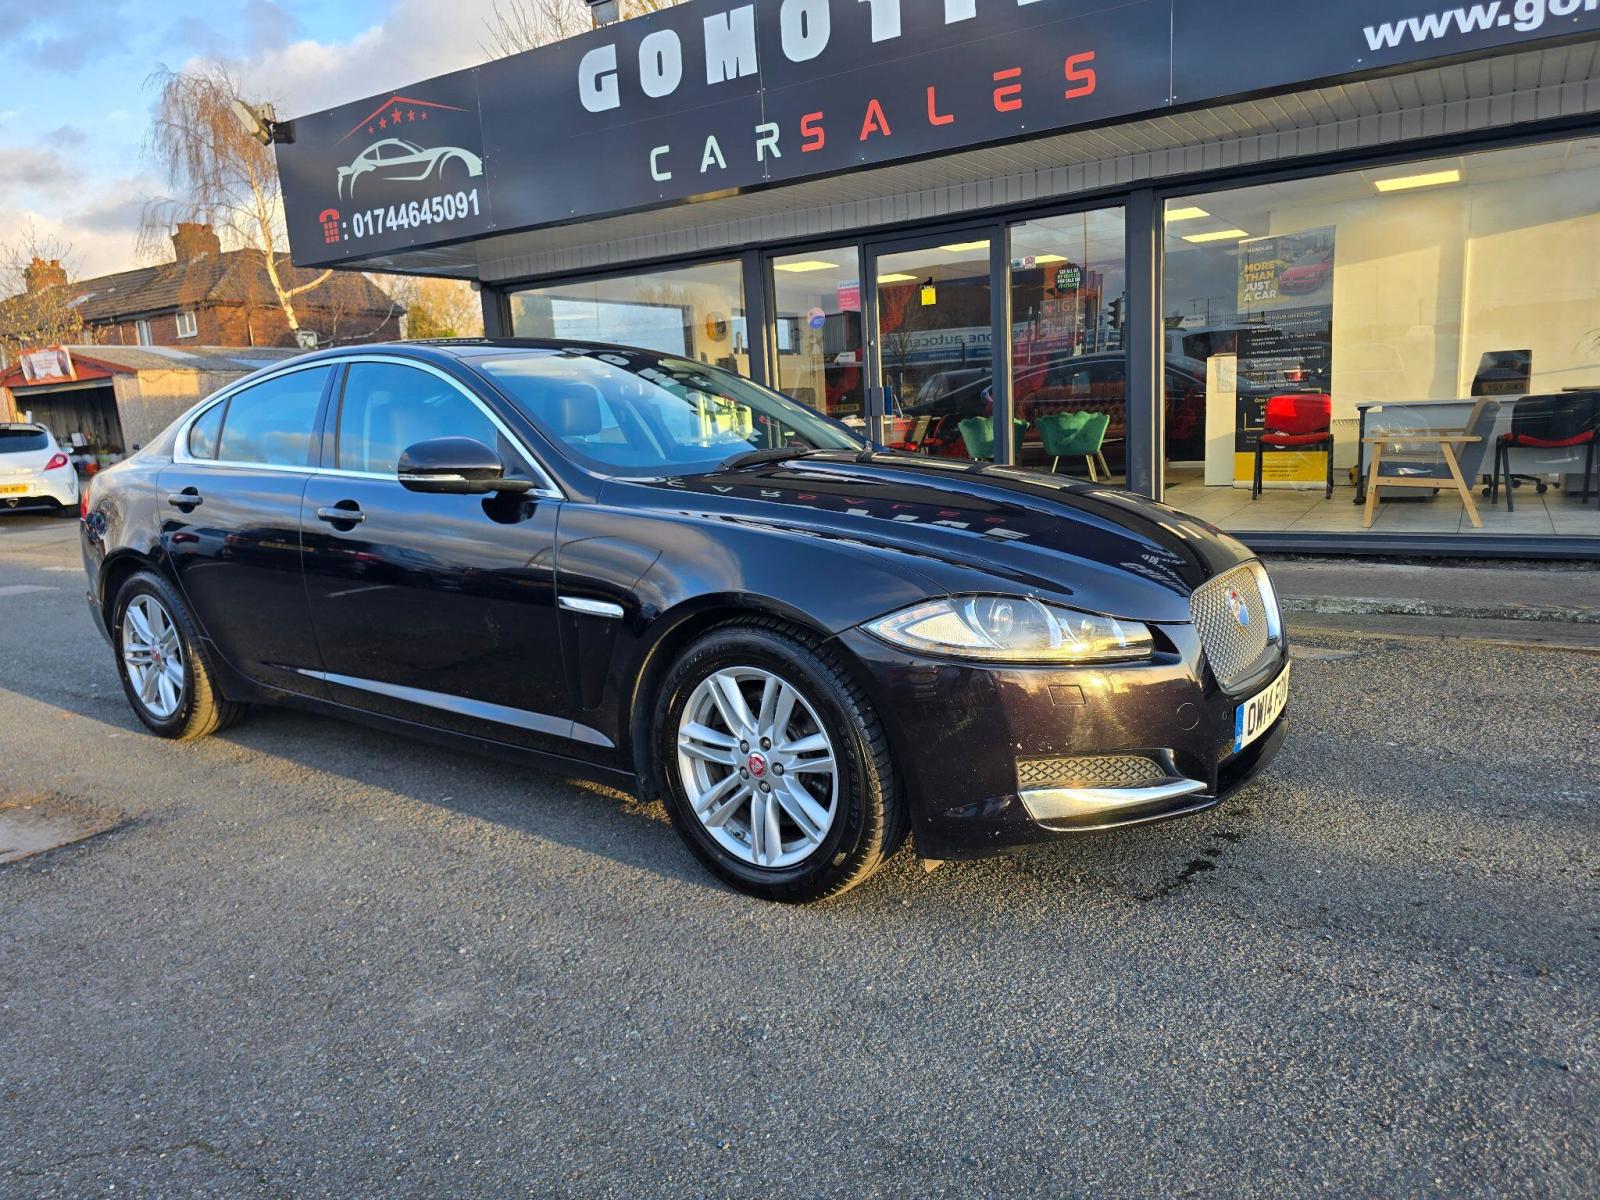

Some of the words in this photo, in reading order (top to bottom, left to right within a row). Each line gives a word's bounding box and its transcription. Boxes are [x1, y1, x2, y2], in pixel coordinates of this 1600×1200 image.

[650, 122, 782, 183] CAR
[800, 50, 1097, 153] SALES
[1244, 261, 1275, 273] MORE
[1244, 270, 1274, 283] THAN
[1244, 280, 1271, 293] JUST
[1254, 290, 1277, 301] CAR
